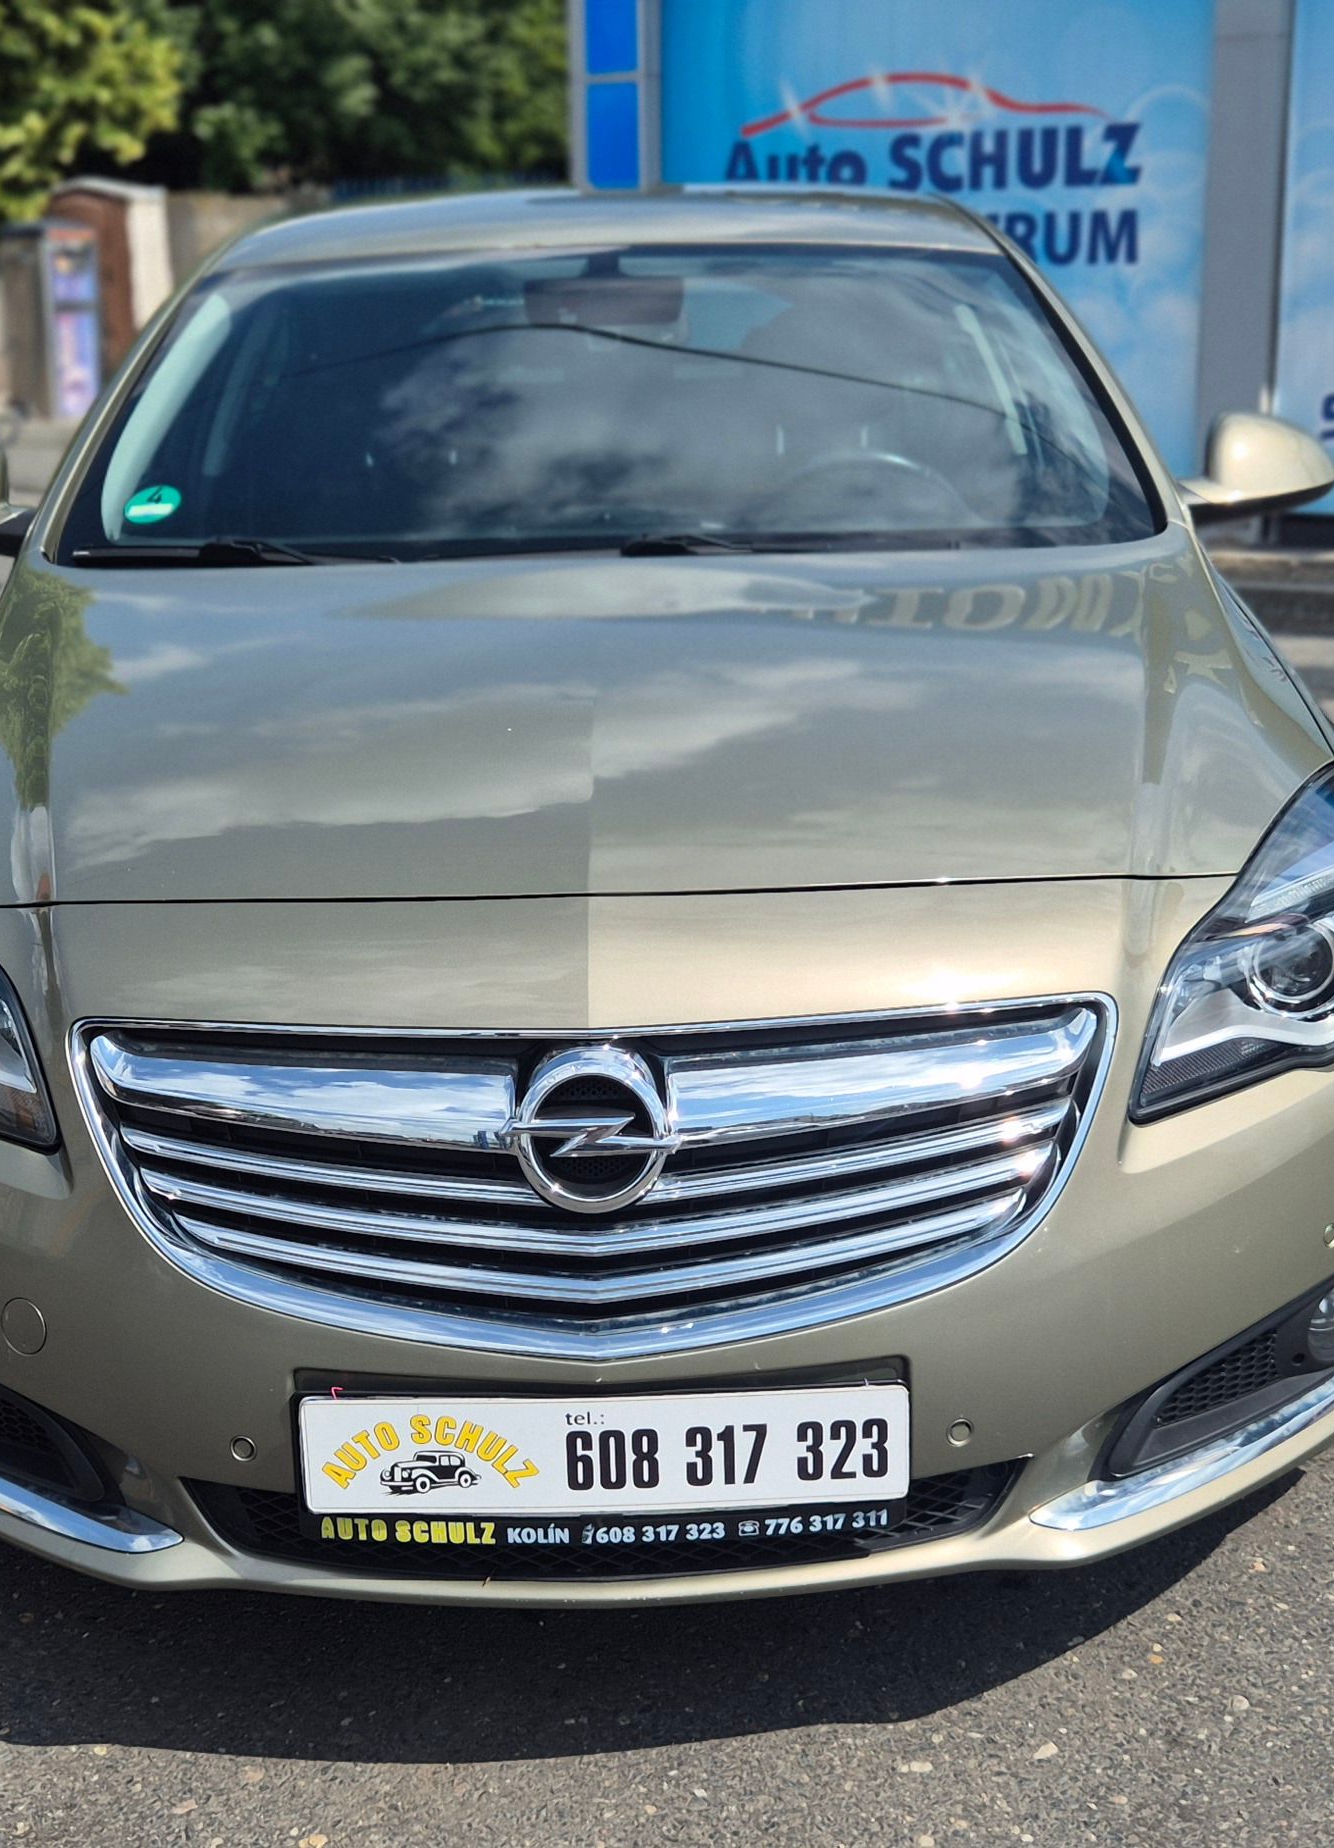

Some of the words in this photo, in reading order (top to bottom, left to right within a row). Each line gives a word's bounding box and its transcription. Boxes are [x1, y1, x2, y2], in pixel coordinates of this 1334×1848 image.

[725, 141, 869, 184] Auto
[888, 123, 1142, 193] SCHULZ
[321, 1420, 401, 1490] AUTO
[409, 1413, 540, 1489] SCHULZ
[565, 1411, 605, 1426] tel.:
[566, 1428, 659, 1491] 608
[685, 1423, 767, 1486] 317
[796, 1418, 889, 1482] 323
[321, 1516, 388, 1542] AUTO
[395, 1520, 497, 1545] SCHULZ
[507, 1523, 570, 1545] KOLÍN
[595, 1525, 636, 1545] 608
[641, 1524, 680, 1543] 317
[685, 1522, 726, 1541] 323
[765, 1516, 804, 1536] 776
[809, 1512, 846, 1533] 317
[852, 1508, 888, 1529] 311
